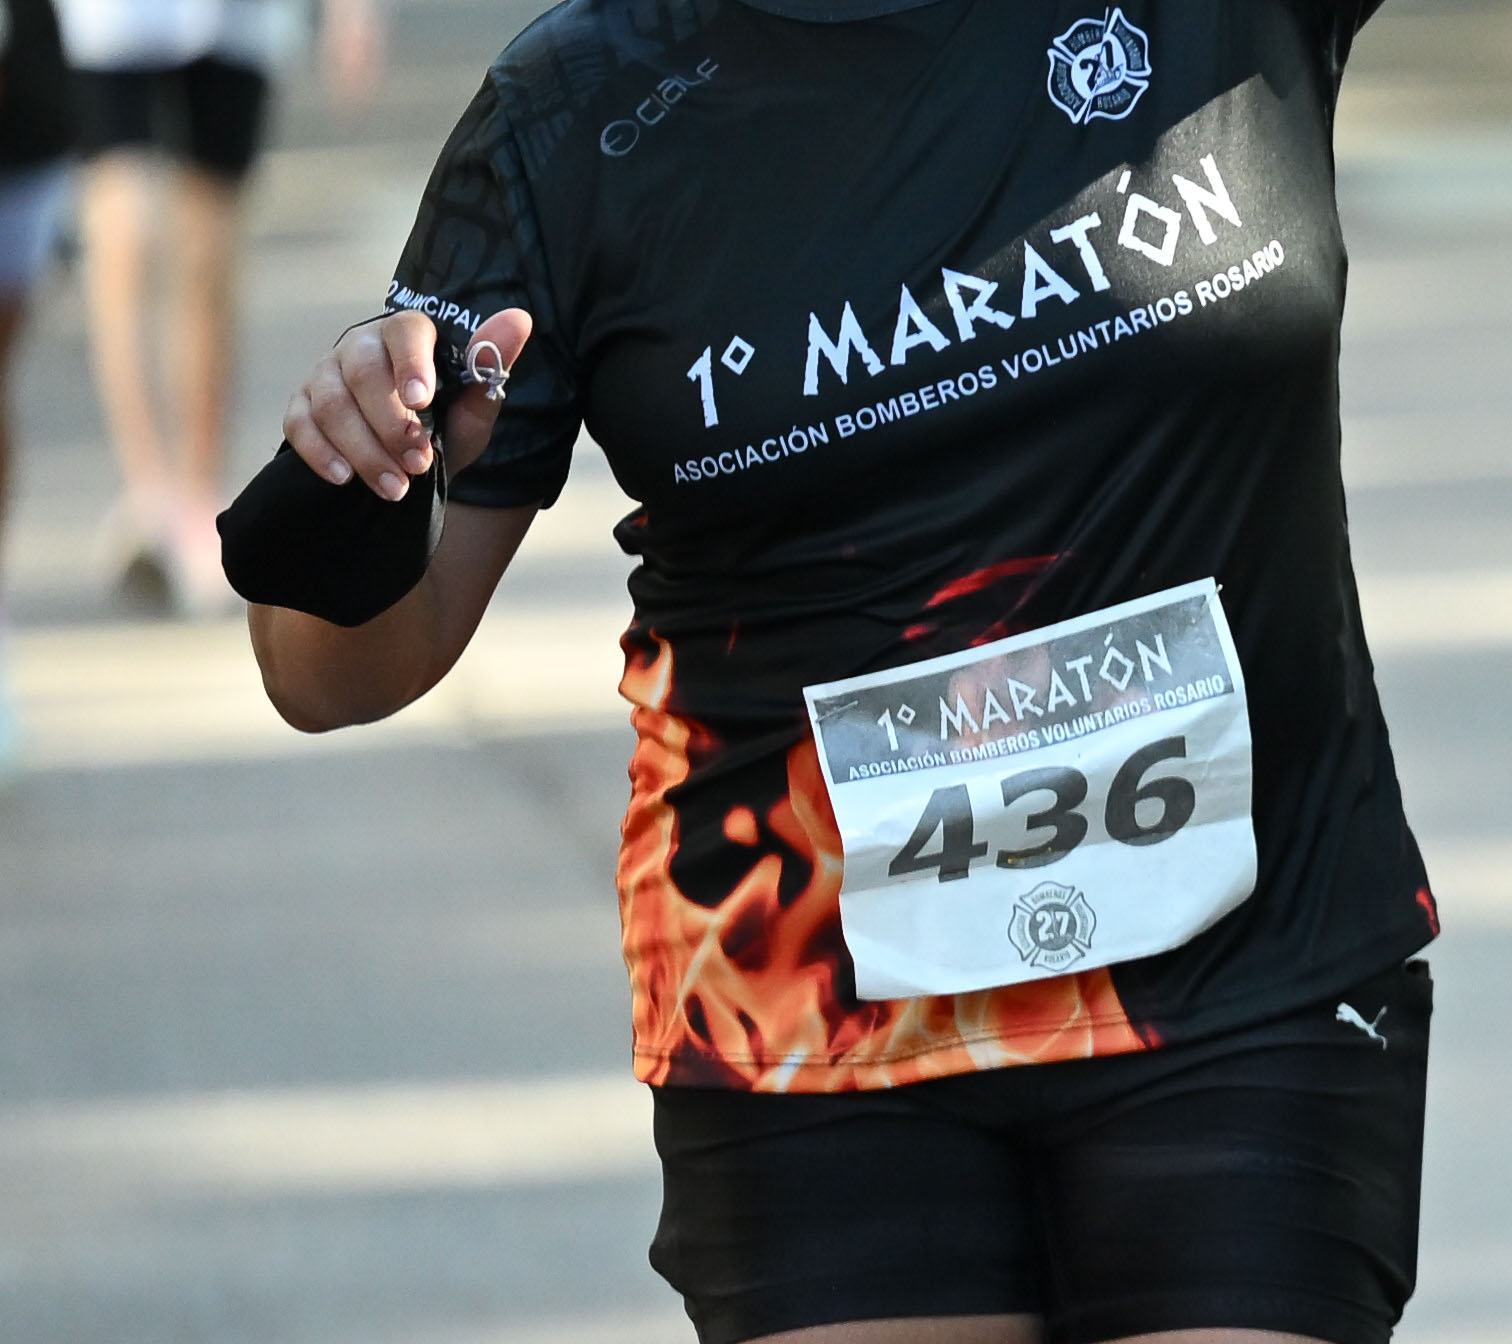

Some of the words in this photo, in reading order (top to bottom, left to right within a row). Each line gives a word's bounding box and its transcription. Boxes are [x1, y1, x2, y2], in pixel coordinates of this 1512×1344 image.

[803, 153, 1243, 397] MARATÓN
[674, 422, 830, 485] ASOCIACIÓN
[835, 365, 998, 439] BOMBEROS
[1001, 290, 1194, 381] VOLUNTARIOS
[1195, 239, 1286, 308] ROSARIO
[848, 752, 948, 781] ASOCIACIÓN
[949, 734, 1041, 767] BOMBEROS
[1040, 700, 1152, 749] VOLUNTARIOS
[1154, 674, 1226, 711] ROSARIO
[938, 632, 1174, 742] MARATÓN
[888, 736, 1197, 884] 436
[1036, 909, 1070, 943] 27
